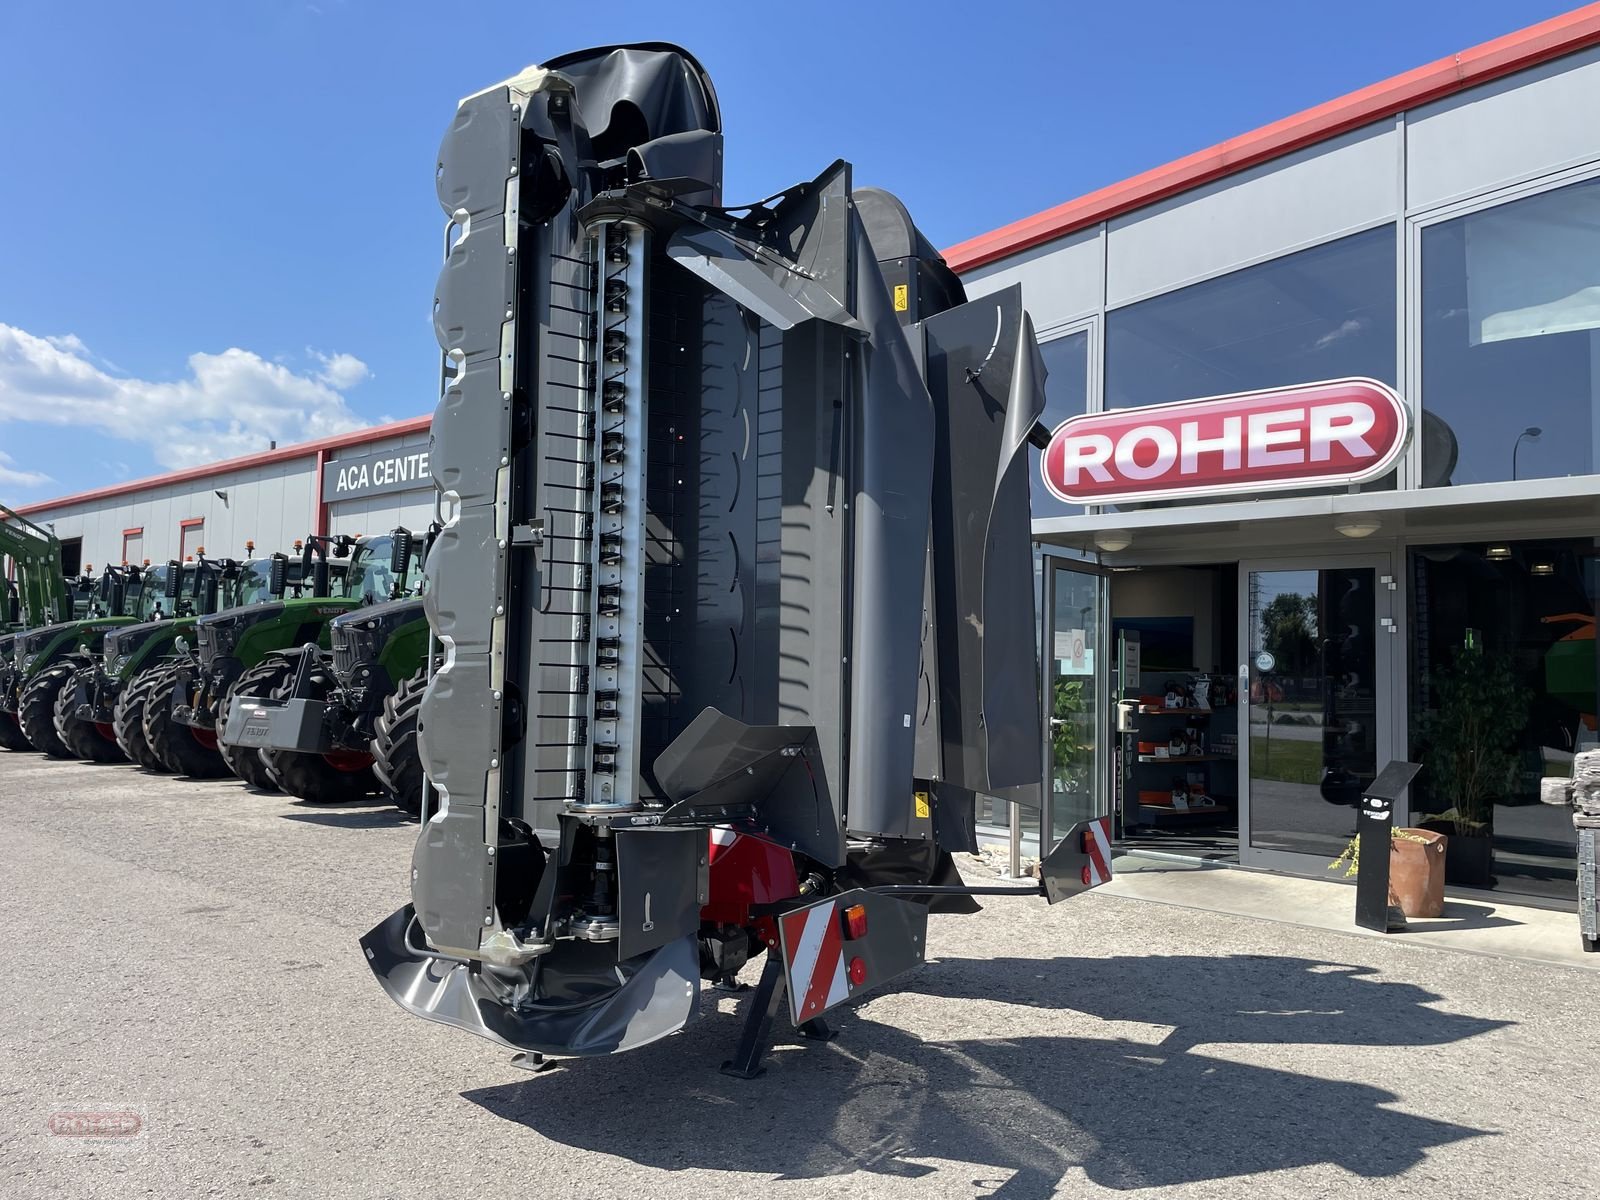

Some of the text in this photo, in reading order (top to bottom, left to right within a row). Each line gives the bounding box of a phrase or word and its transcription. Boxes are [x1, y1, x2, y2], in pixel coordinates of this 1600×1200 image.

[336, 452, 432, 492] ACA CENTE
[1063, 401, 1377, 486] ROHER
